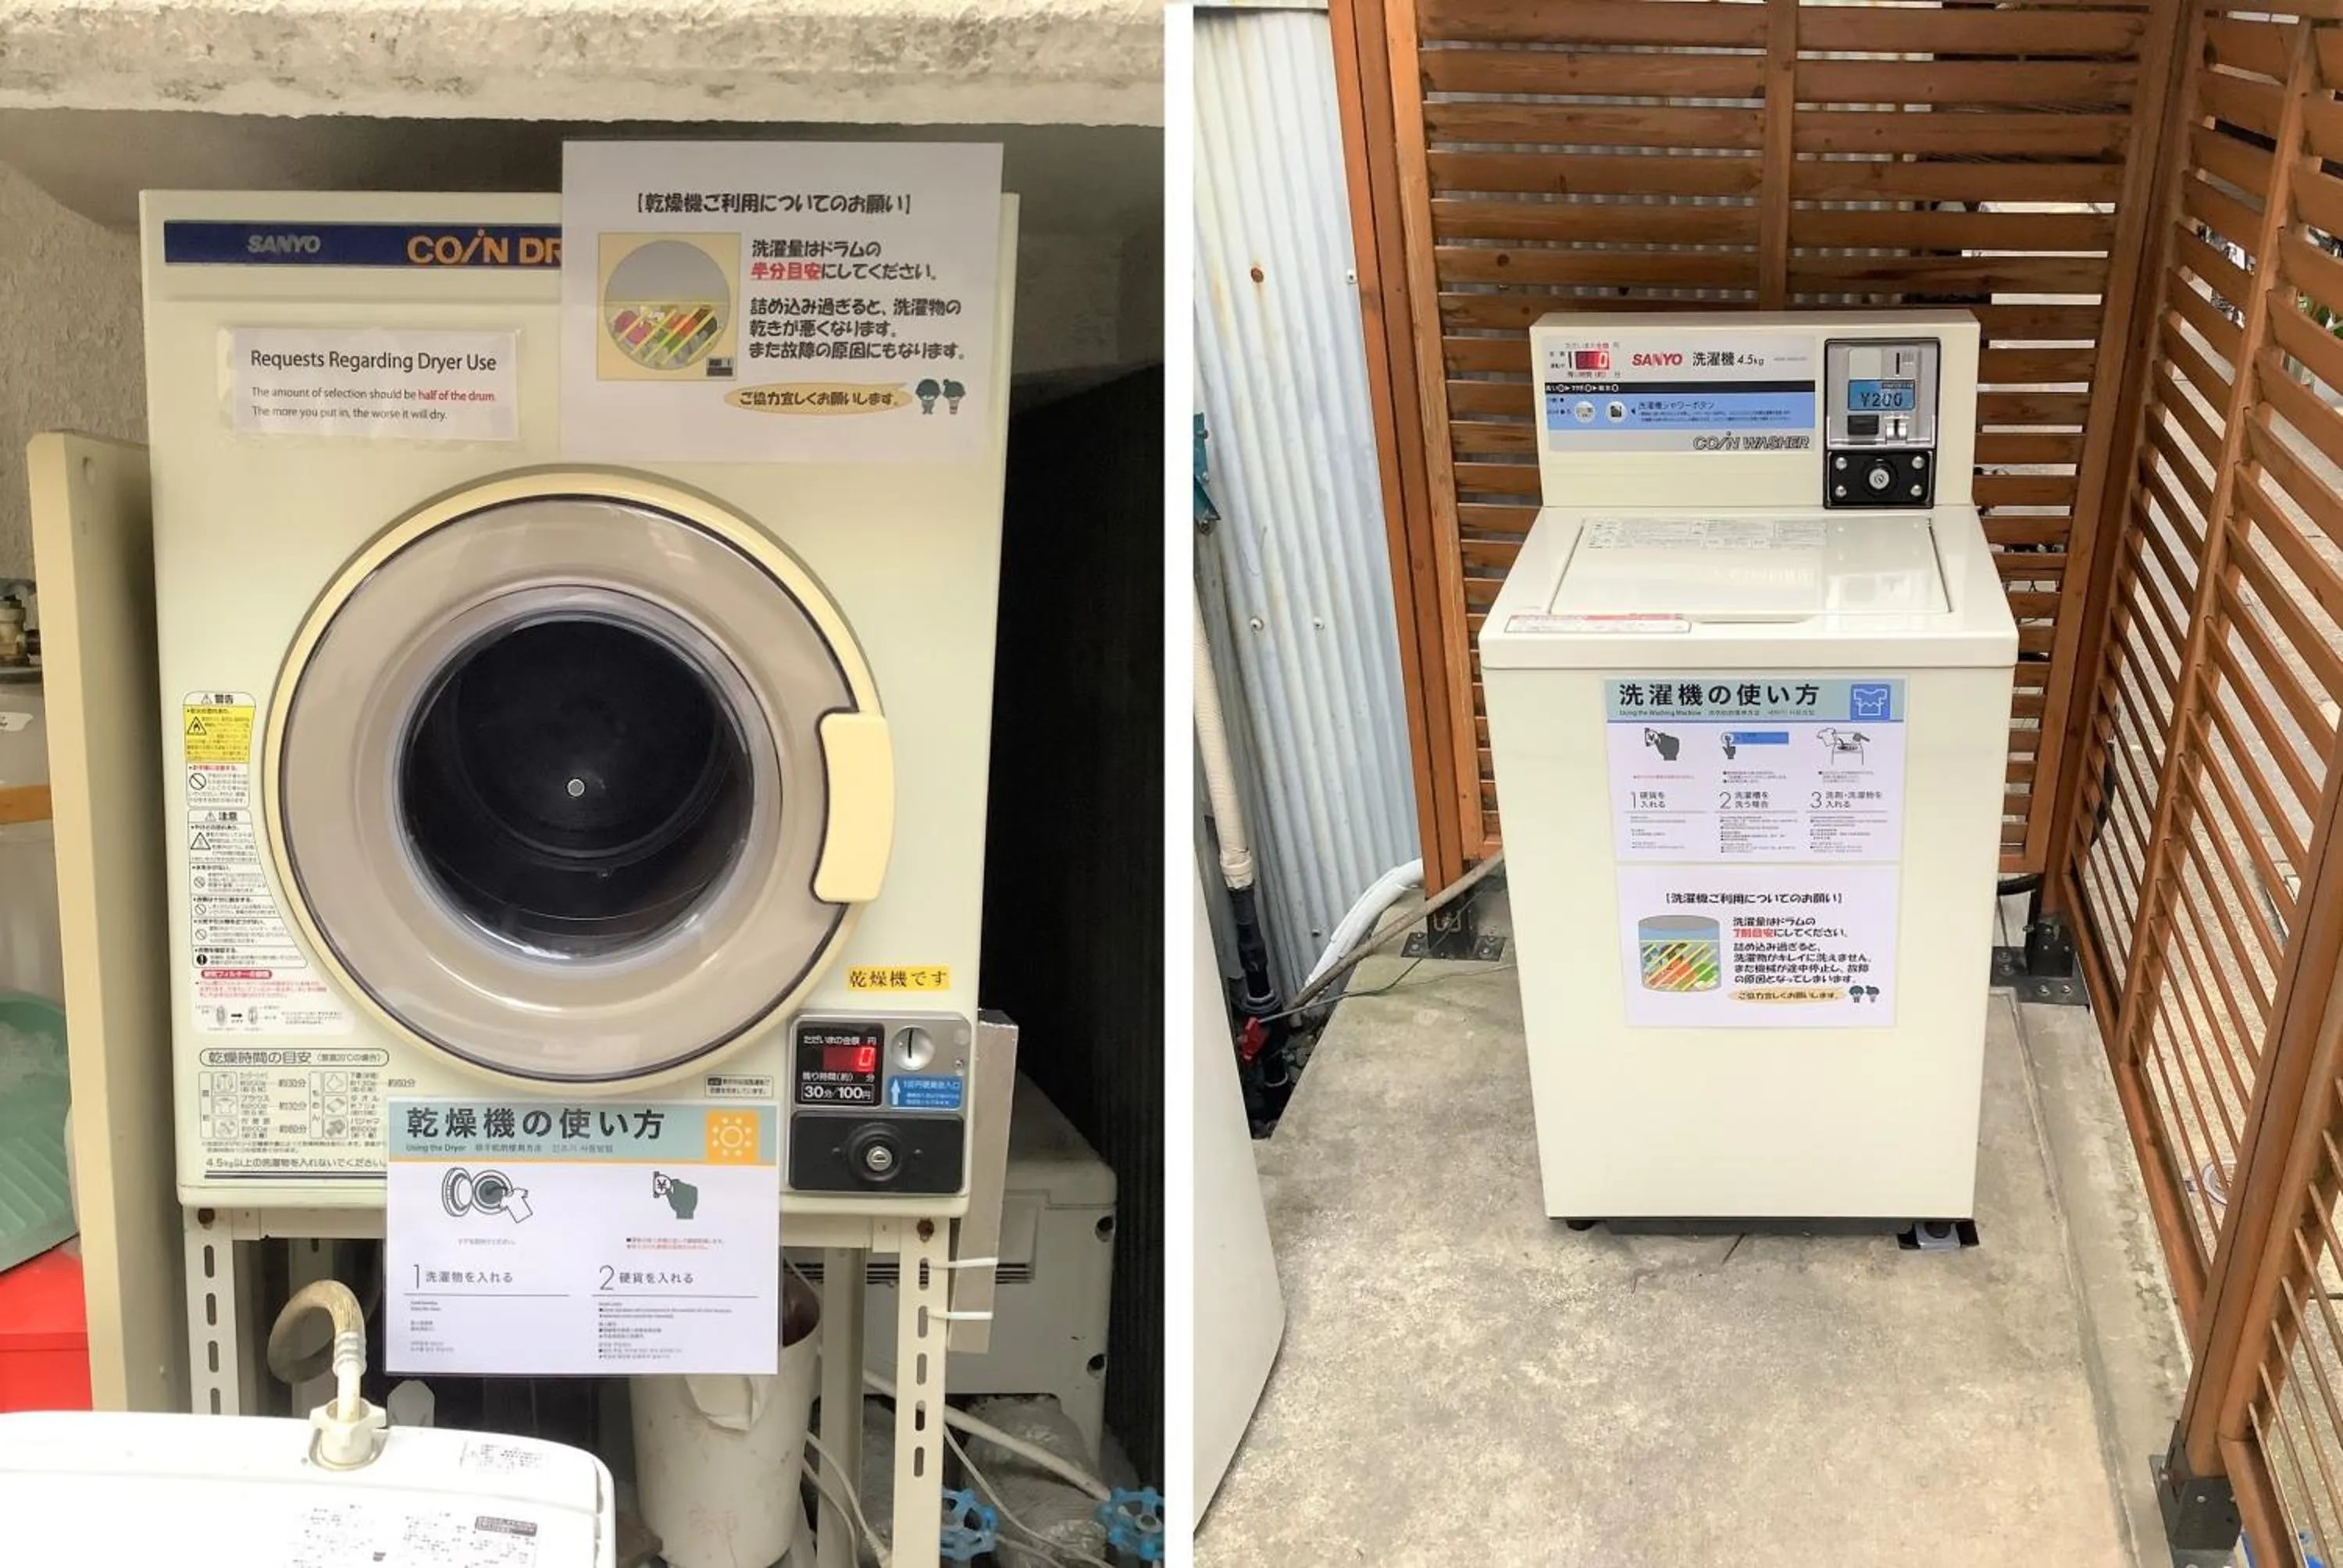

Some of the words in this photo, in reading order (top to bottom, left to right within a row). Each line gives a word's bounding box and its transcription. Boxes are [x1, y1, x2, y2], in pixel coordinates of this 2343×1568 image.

[247, 233, 321, 255] SANYO
[406, 228, 509, 264] COIN
[751, 238, 882, 258] 洗濯量はドラムの
[750, 262, 937, 281] 半分目安にしてください。
[749, 298, 962, 316] 詰め込み過ぎると、洗濯物の
[749, 319, 897, 338] 乾きが悪くなります。
[748, 341, 965, 360] また故障の原因にもなります。
[1632, 353, 1684, 366] SANYO
[1692, 351, 1735, 367] 洗濯機
[1736, 355, 1765, 367] 4.5kg
[250, 350, 325, 370] Requests
[329, 351, 414, 373] Regarding
[417, 352, 462, 374] Dryer
[466, 353, 497, 372] Use
[251, 387, 270, 398] The
[271, 388, 310, 399] amount
[312, 387, 323, 398] of
[323, 388, 368, 400] selection
[369, 389, 402, 400] should
[403, 389, 416, 400] be
[418, 390, 437, 401] half
[438, 390, 449, 401] of
[450, 390, 466, 401] the
[739, 390, 899, 406] ご協力宜しくお願いします。
[251, 405, 270, 417] The
[272, 408, 298, 418] more
[299, 408, 318, 420] you
[319, 408, 337, 420] put
[352, 408, 370, 419] the
[370, 409, 401, 419] worse
[402, 409, 409, 419] it
[410, 409, 428, 419] will
[429, 410, 448, 422] dry.
[1742, 436, 1810, 450] WASHER
[1619, 683, 1820, 707] 洗濯機の使い方
[1631, 791, 1637, 810] 1
[1718, 791, 1732, 810] 2
[1810, 791, 1823, 810] 3
[1825, 800, 1852, 809] 入れる
[1732, 917, 1817, 927] 洗濯量はドラムの
[849, 970, 947, 988] 乾燥機です
[858, 1046, 876, 1067] 0
[405, 1106, 665, 1140] 乾燥機の使い方
[444, 1143, 467, 1153] Dryer
[412, 1263, 419, 1290] 1
[426, 1270, 514, 1283] 洗濯物を入れる
[599, 1264, 615, 1291] 2
[619, 1271, 694, 1285] 硬貨を入れる
